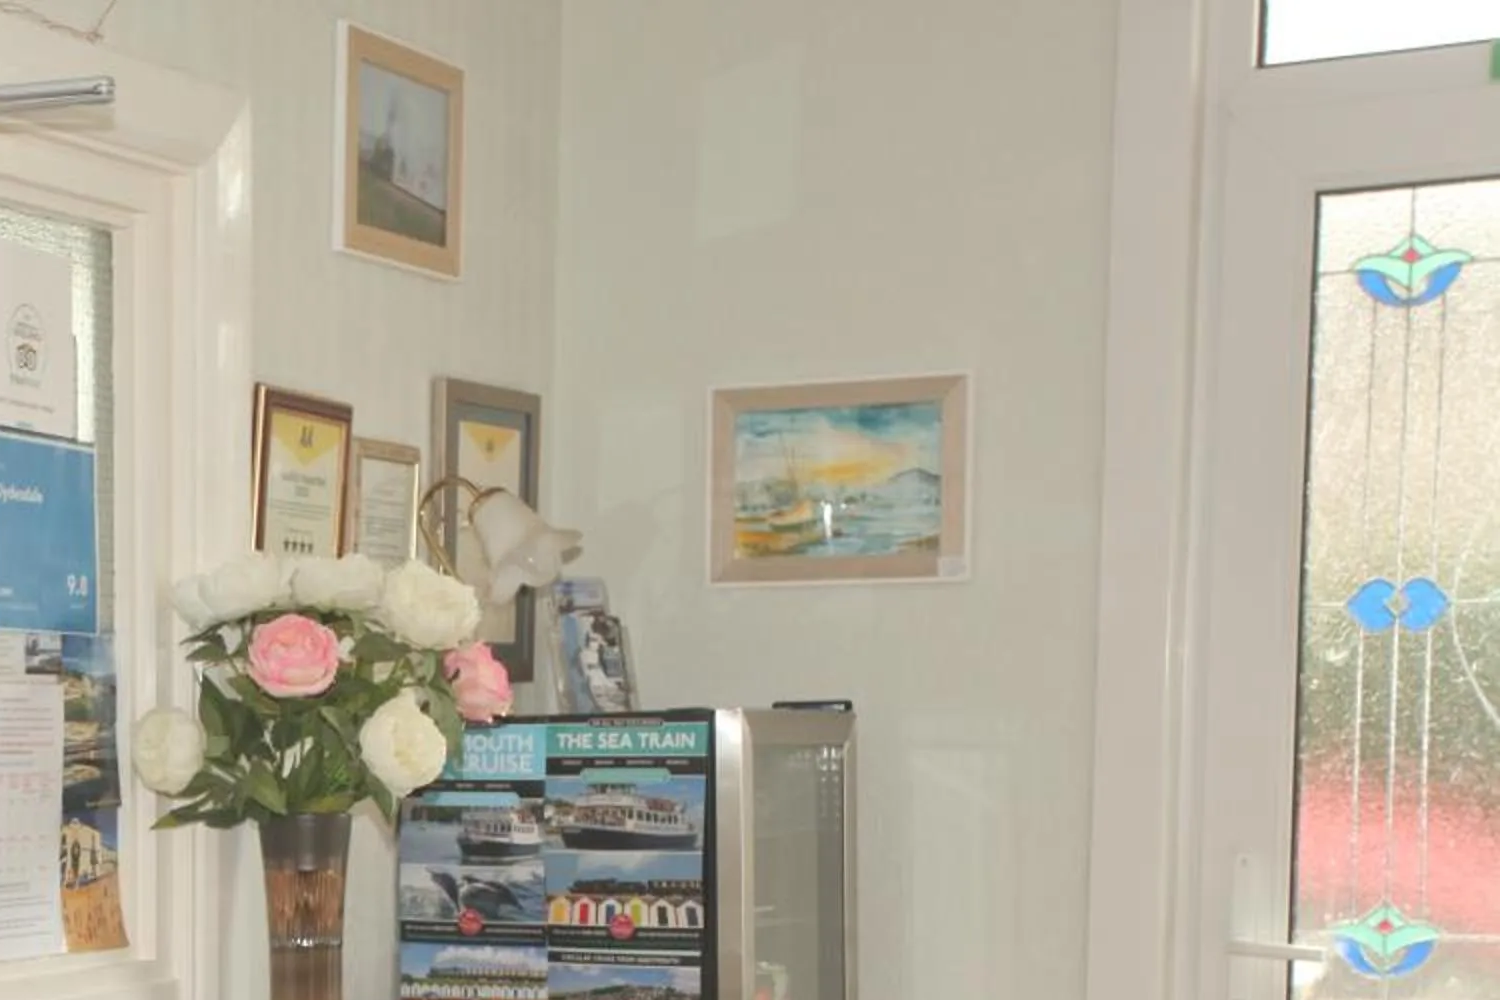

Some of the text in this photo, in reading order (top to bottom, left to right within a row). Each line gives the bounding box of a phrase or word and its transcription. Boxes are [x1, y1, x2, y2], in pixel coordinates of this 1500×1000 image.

[463, 734, 533, 751] OUTH
[557, 731, 696, 749] THE SEA TRAIN
